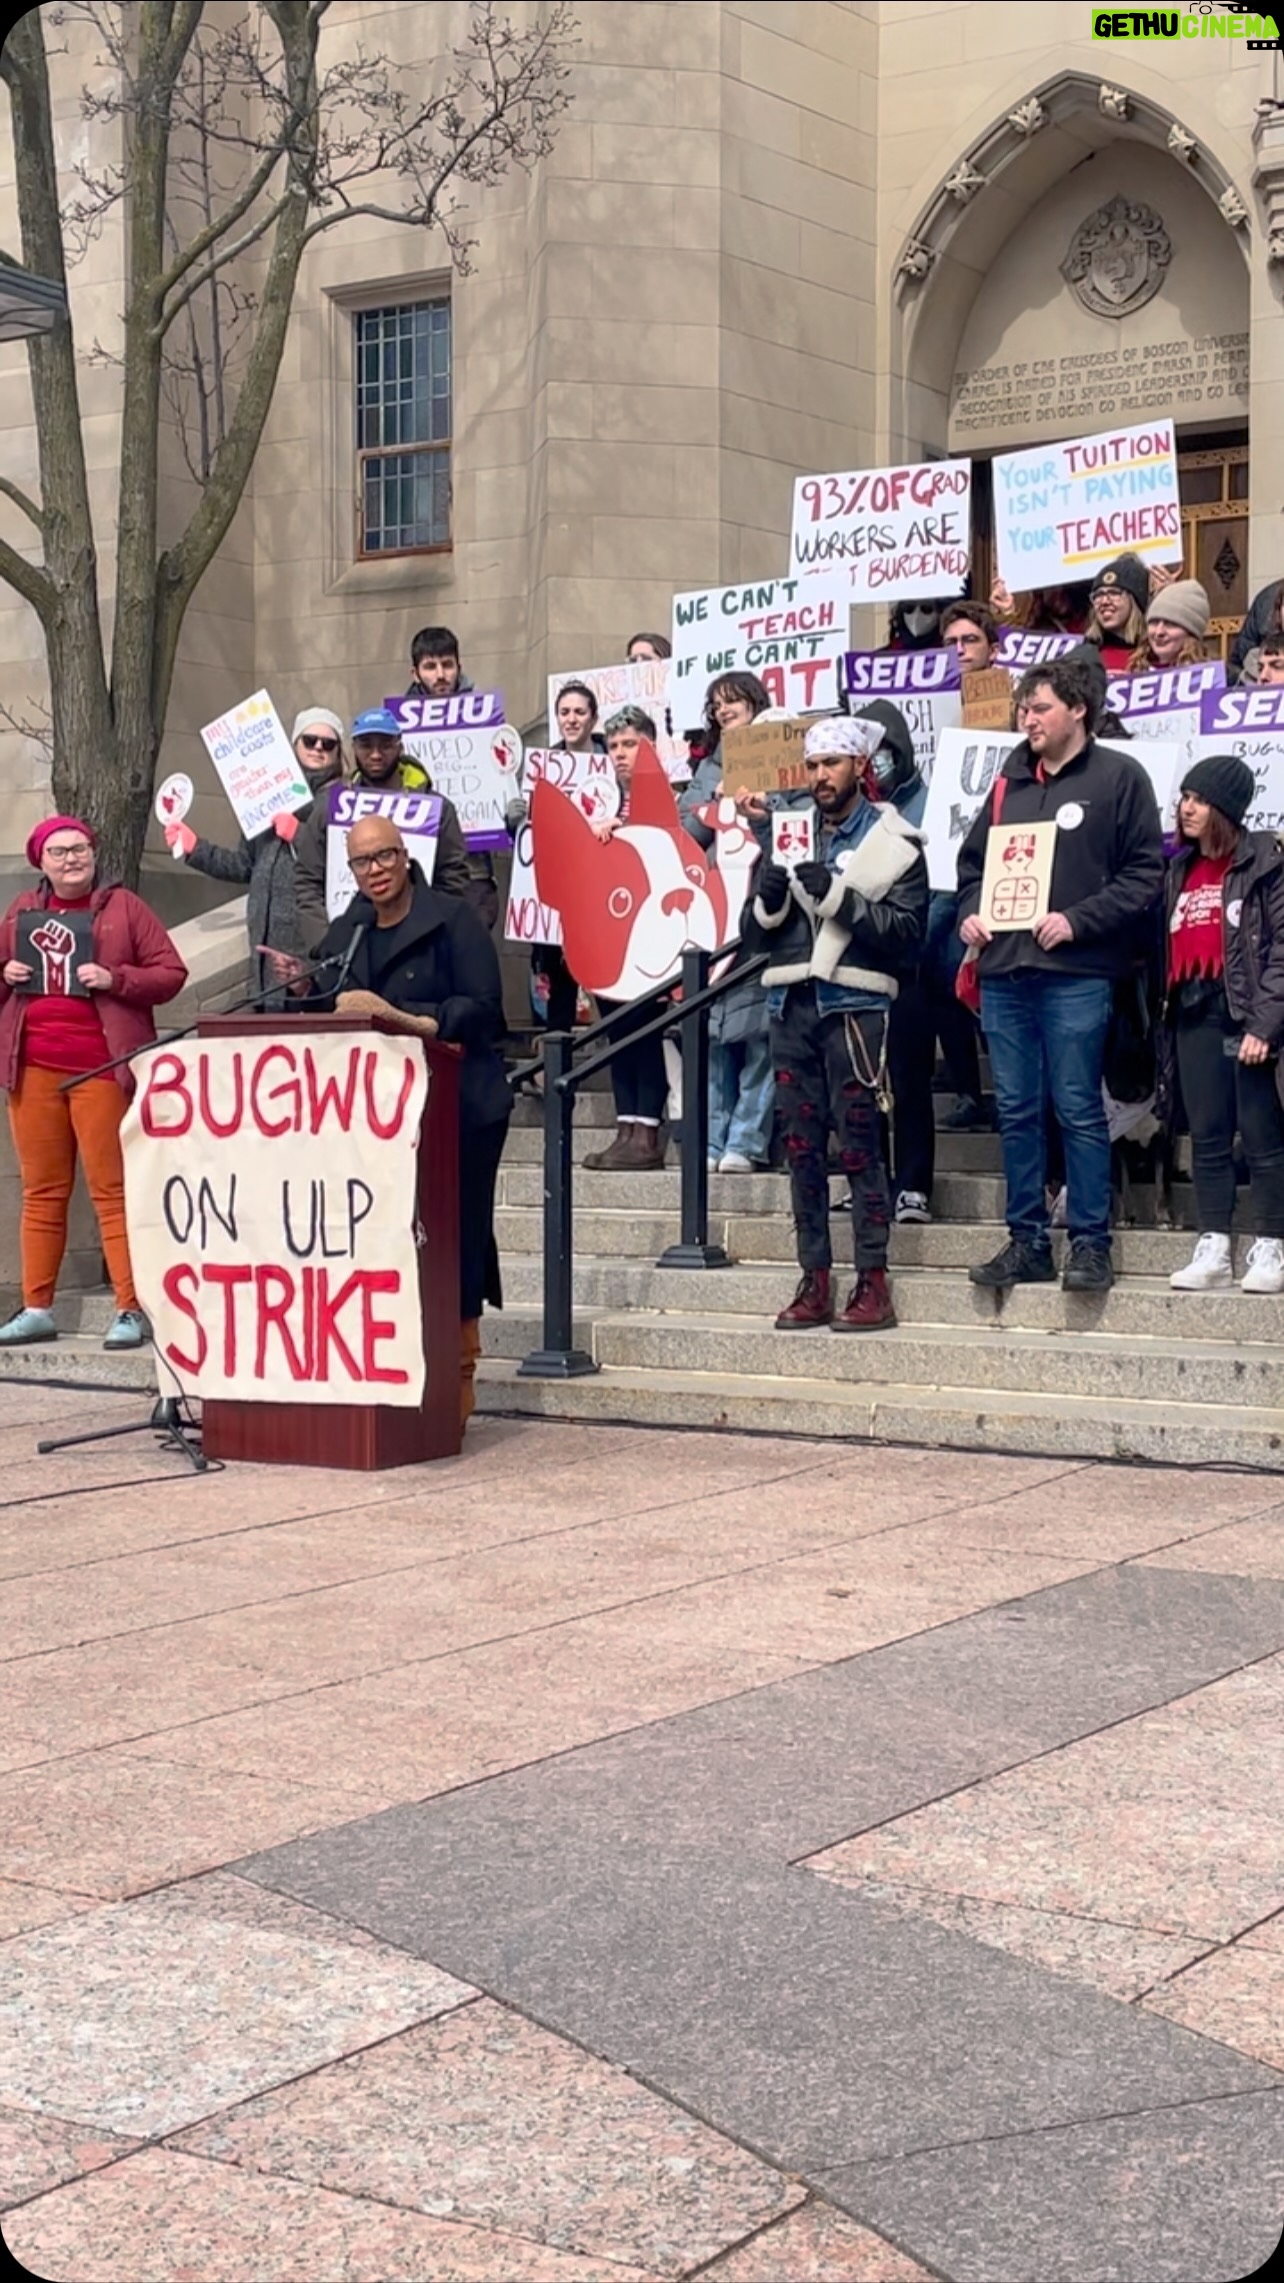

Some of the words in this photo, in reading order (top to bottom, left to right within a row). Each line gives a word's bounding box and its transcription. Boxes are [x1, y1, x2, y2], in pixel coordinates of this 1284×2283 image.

[972, 366, 1010, 383] ORDER
[1013, 363, 1028, 377] OF
[1123, 348, 1138, 362] OF
[1143, 340, 1188, 360] BOSTON
[1002, 381, 1012, 395] IS
[1060, 372, 1081, 388] FOR
[1087, 362, 1148, 384] PRESIDENT
[1038, 392, 1053, 406] OF
[1212, 367, 1237, 383] AND
[1121, 392, 1172, 411] RELIGION
[1178, 389, 1202, 403] AND
[999, 461, 1058, 489] YOUR
[1063, 430, 1170, 473] TUITION
[1009, 483, 1072, 516] ISN'T
[1085, 463, 1173, 504] PAYING
[795, 524, 897, 563] WORKERS
[905, 511, 961, 548] ARE
[1008, 526, 1056, 552] YOUR
[1056, 503, 1178, 553] TEACHERS
[868, 549, 969, 589] BURDENED
[676, 596, 709, 626] WE
[720, 580, 798, 616] CAN'T
[738, 601, 834, 640] TEACH
[677, 656, 698, 677] IF
[706, 648, 737, 673] WE
[745, 636, 824, 667] CAN'T
[853, 654, 949, 690] SEIU
[761, 659, 832, 707] AT
[1106, 667, 1215, 712] SEIU
[398, 694, 495, 729] SEIU
[214, 717, 274, 761] childcare
[240, 732, 275, 758] costs
[241, 788, 296, 831] INCOME
[334, 791, 432, 829] SEIU
[141, 1045, 415, 1140] BUGWU
[163, 1173, 238, 1250] ON
[283, 1178, 373, 1258] ULP
[163, 1263, 408, 1384] STRIKE
